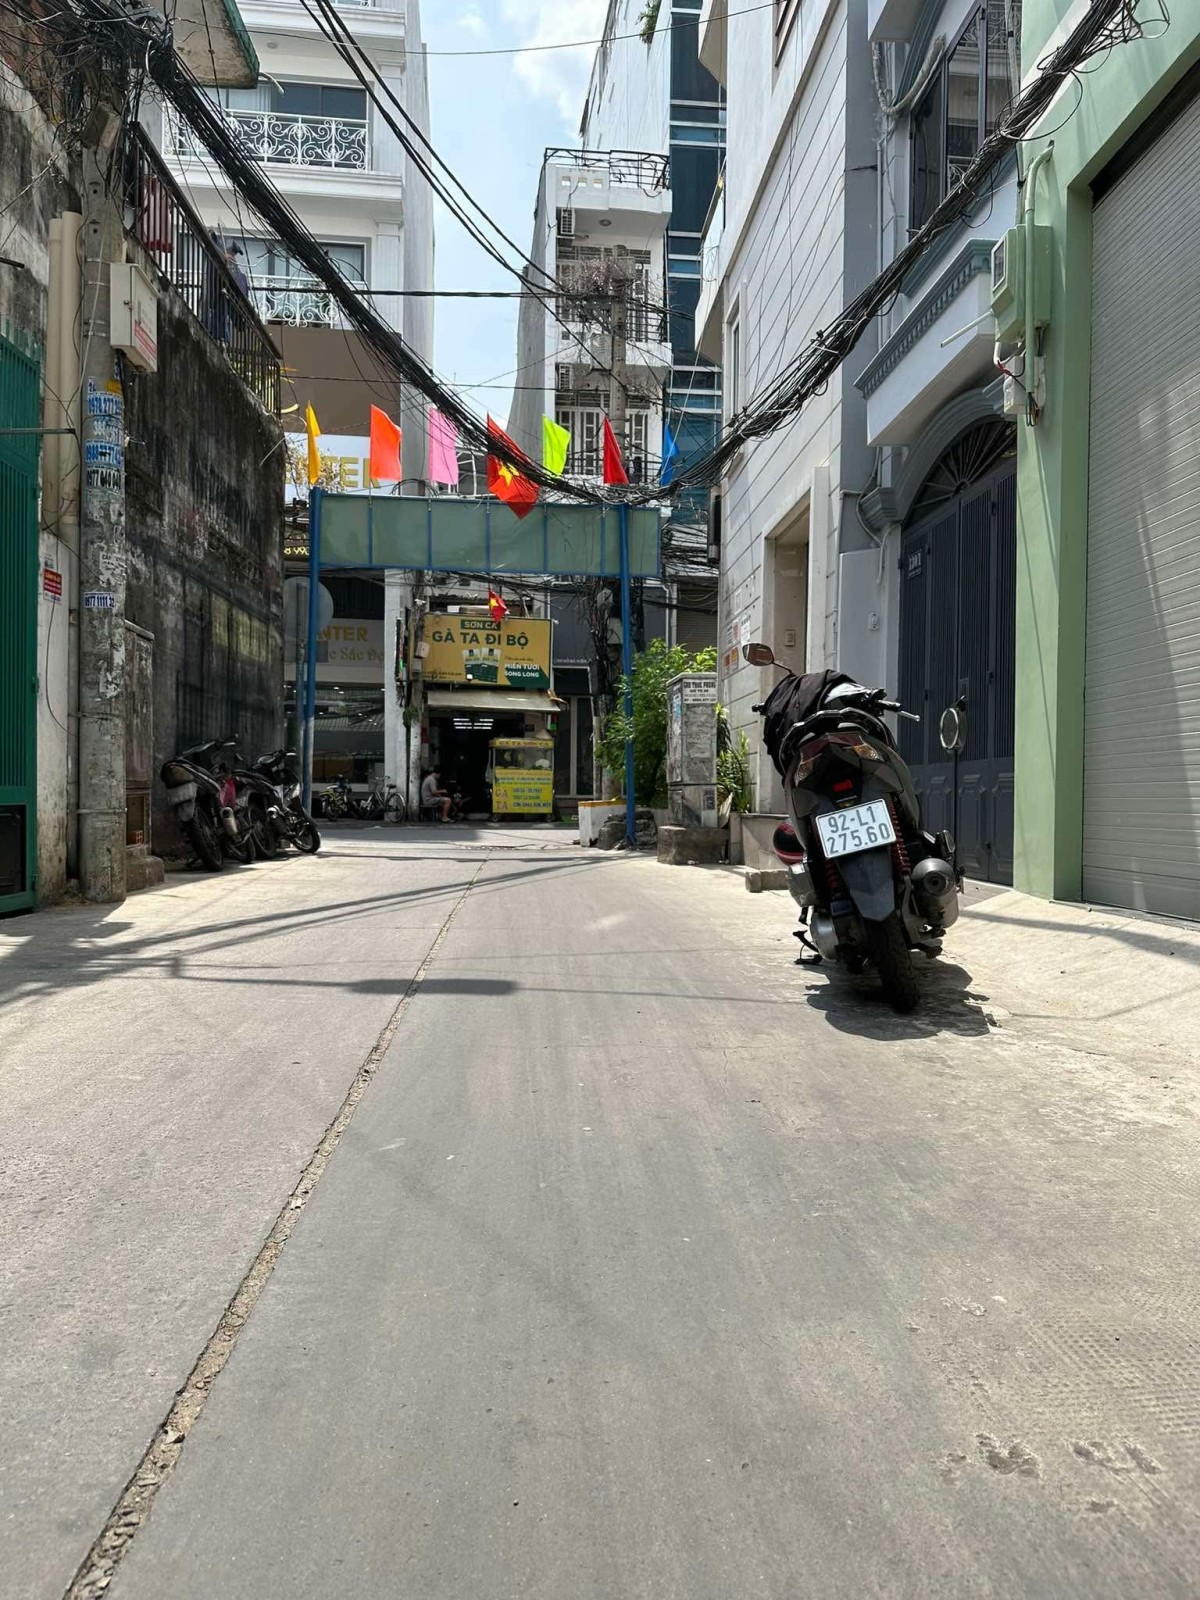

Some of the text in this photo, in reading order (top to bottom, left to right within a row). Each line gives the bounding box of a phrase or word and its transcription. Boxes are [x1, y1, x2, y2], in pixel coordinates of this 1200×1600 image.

[464, 620, 484, 630] SƠN
[432, 627, 529, 650] GÀ TA ĐI BỘ
[827, 805, 877, 834] 92-L1
[826, 822, 891, 855] 275.60
